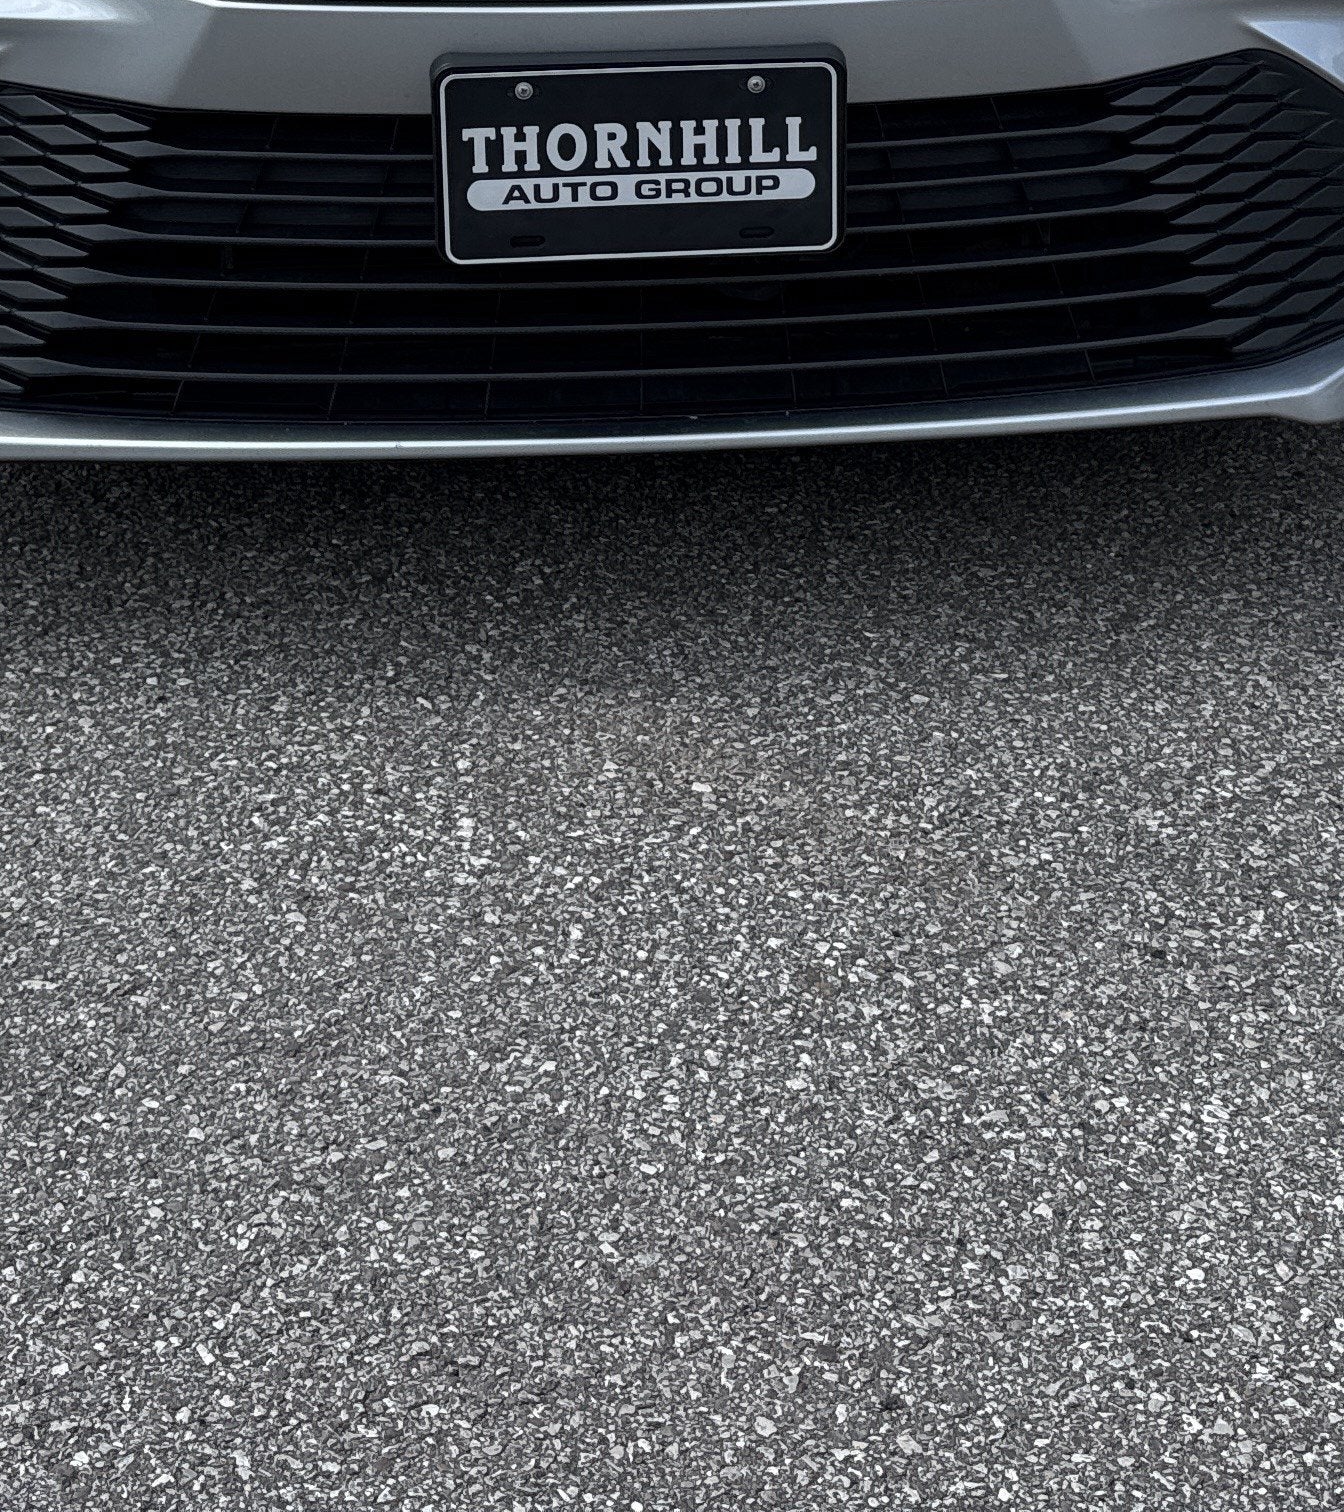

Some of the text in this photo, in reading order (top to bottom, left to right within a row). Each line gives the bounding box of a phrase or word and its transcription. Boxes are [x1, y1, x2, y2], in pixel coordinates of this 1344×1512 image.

[462, 117, 817, 173] THORNHILL
[502, 175, 781, 205] AUTO GROUP
